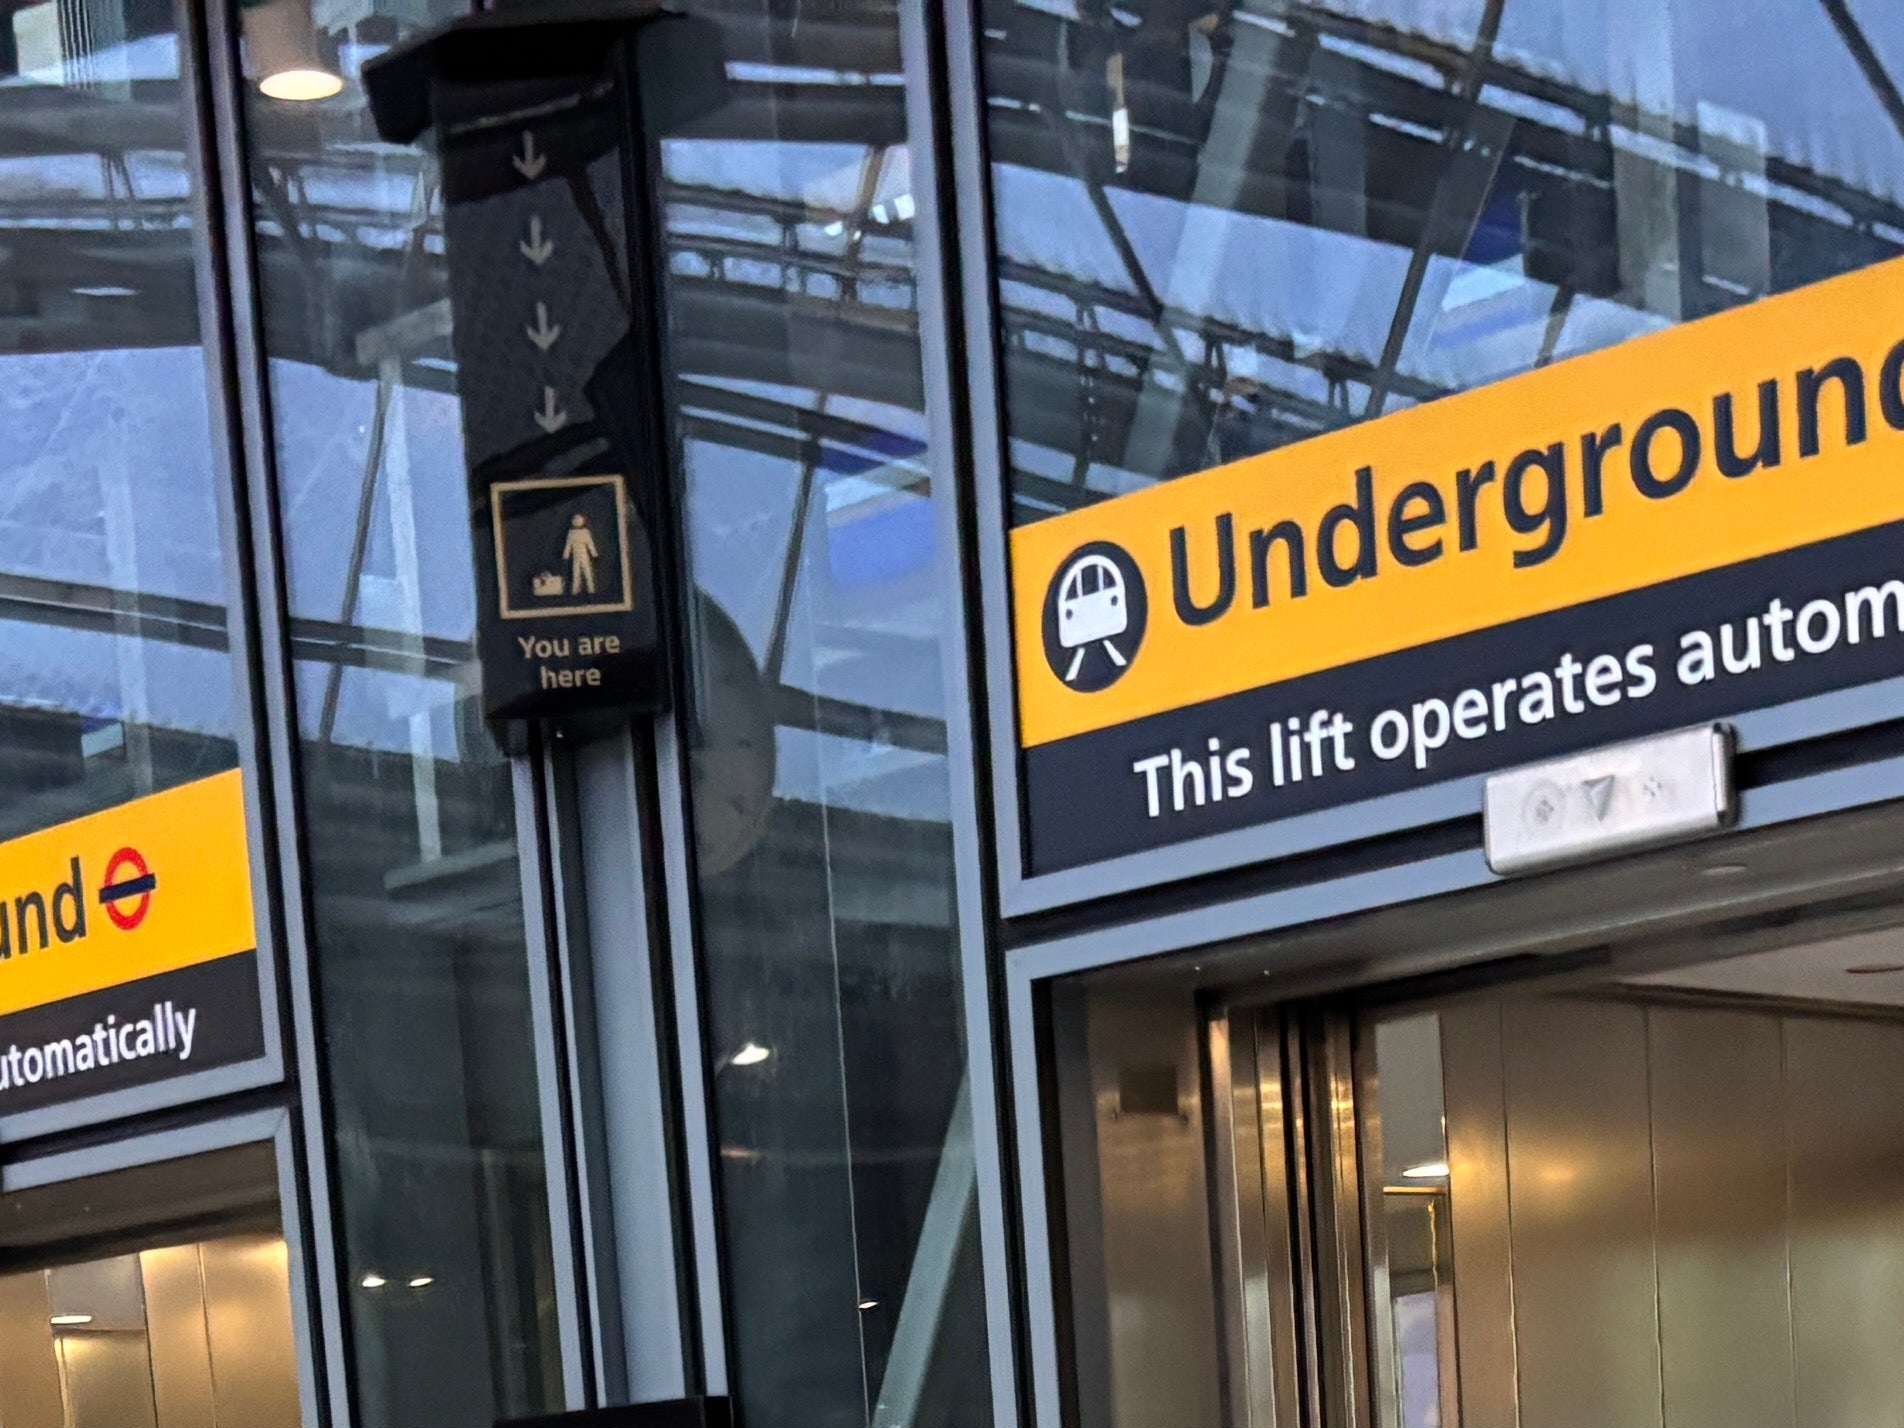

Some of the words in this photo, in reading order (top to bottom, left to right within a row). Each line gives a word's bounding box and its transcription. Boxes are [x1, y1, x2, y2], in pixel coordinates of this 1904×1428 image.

[517, 634, 571, 660] You
[579, 632, 621, 656] are
[540, 663, 603, 691] here
[1132, 732, 1256, 821] This
[1268, 706, 1357, 787] lift
[1368, 648, 1660, 767] operates
